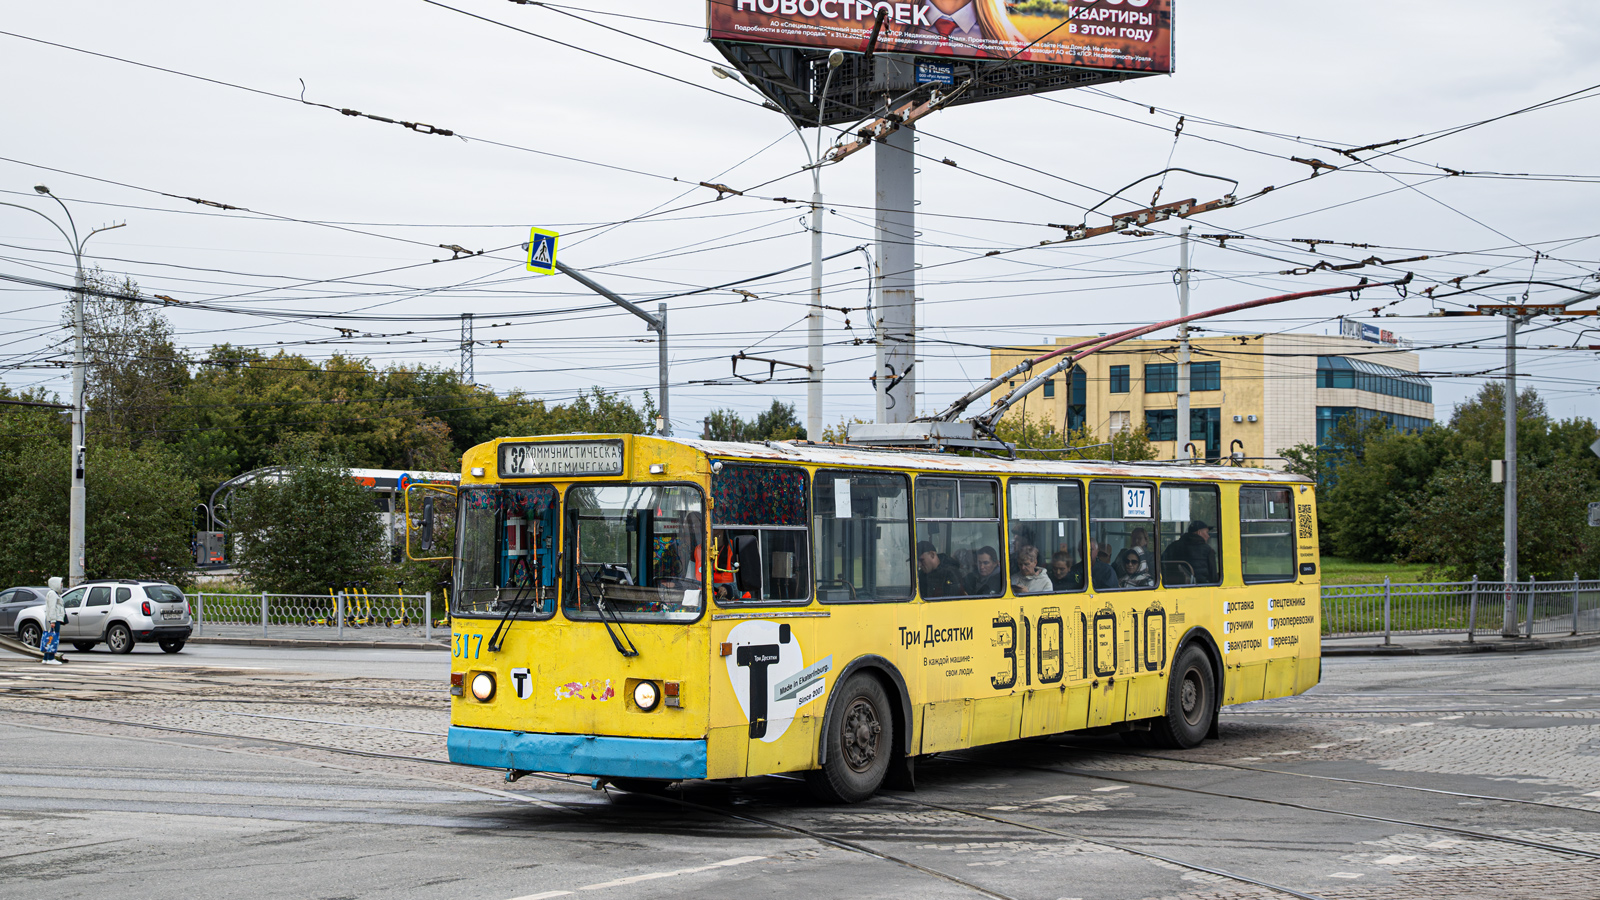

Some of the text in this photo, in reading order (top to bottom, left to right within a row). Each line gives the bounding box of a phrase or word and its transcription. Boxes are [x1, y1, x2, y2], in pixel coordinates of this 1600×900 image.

[736, 0, 931, 27] НОВОСТРОЕК
[1069, 6, 1153, 26] КВАРТИРЫ
[734, 24, 775, 33] Подробности
[928, 64, 951, 74] Russ
[511, 447, 525, 473] 32
[1127, 489, 1145, 508] 317
[1226, 600, 1255, 614] доставка
[1269, 597, 1306, 610] спецтехника
[1226, 620, 1254, 634] грузчики
[1270, 615, 1315, 630] грузоперевозки
[898, 624, 974, 650] Три Десятки
[1270, 634, 1299, 648] переезды
[453, 632, 483, 659] 317
[1227, 638, 1262, 652] эвакуаторы
[923, 657, 928, 667] В
[929, 655, 949, 667] каждой
[950, 655, 971, 664] машине
[779, 682, 793, 696] Made
[793, 679, 799, 687] in
[798, 685, 824, 706] Since 2007
